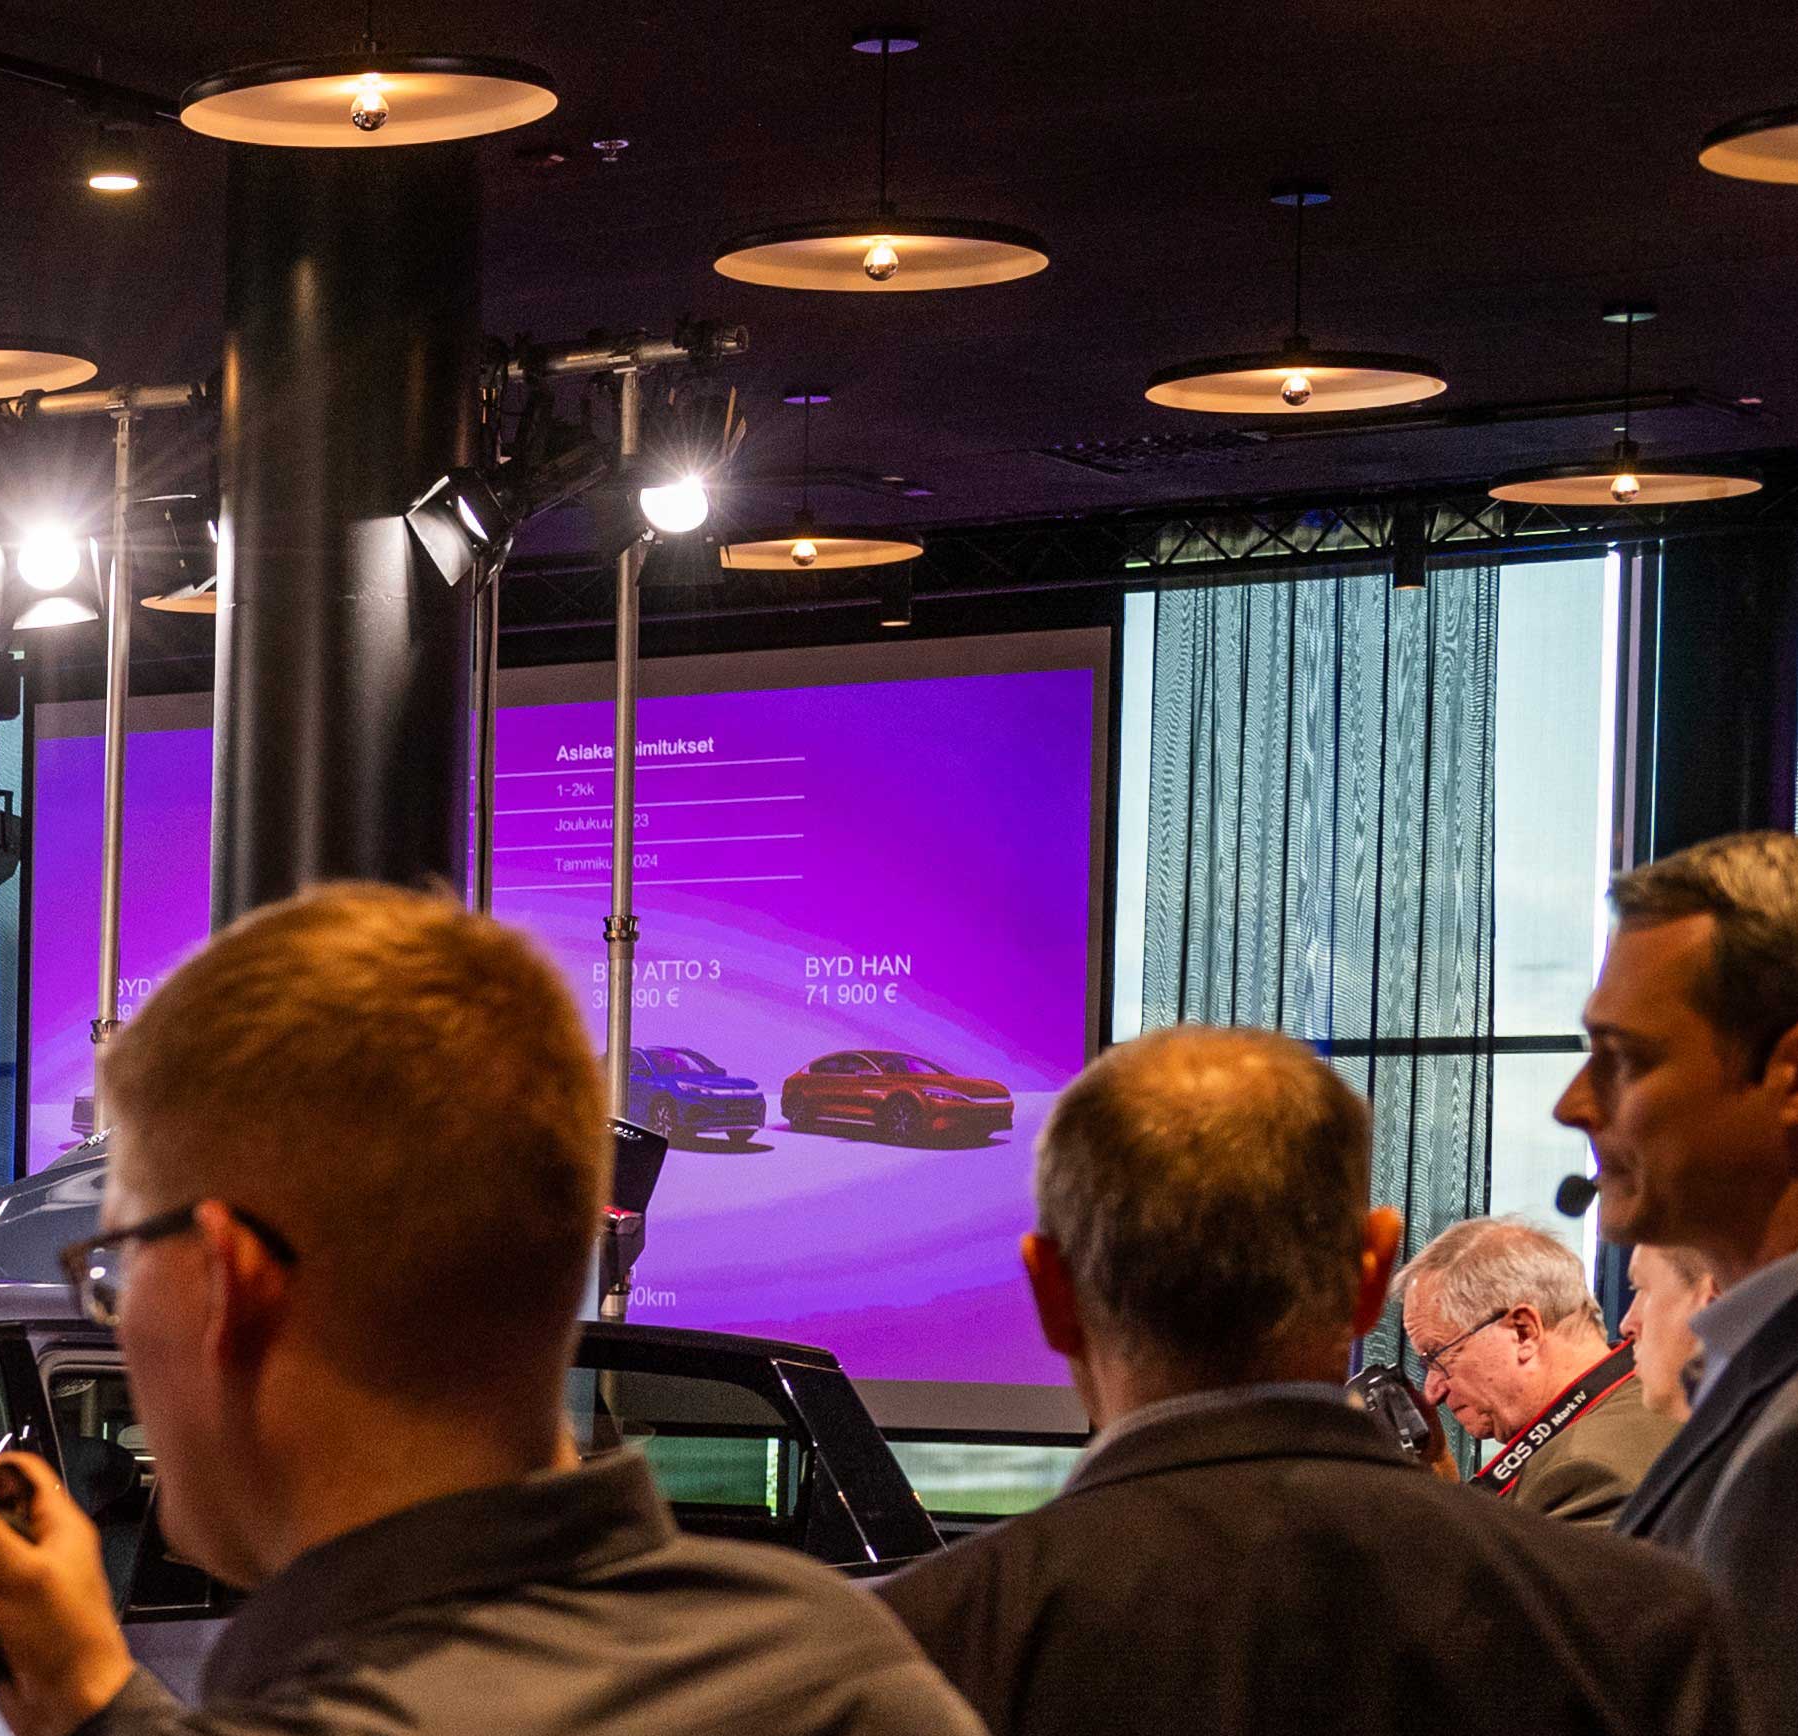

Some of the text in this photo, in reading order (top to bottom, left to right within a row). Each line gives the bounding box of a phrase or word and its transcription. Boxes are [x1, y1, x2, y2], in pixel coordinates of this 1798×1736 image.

[556, 735, 715, 762] Asiakaimitukset
[556, 782, 595, 797] 1-2kk
[555, 816, 613, 832] Joulukuu
[555, 854, 658, 872] Tammiku 024
[643, 960, 702, 981] ATTO
[708, 959, 721, 980] 3
[805, 955, 912, 978] BYD HAN
[631, 987, 661, 1009] 90
[666, 987, 681, 1008] €
[805, 983, 899, 1005] 71 900 €
[1492, 1389, 1587, 1480] EOS 5D Mark IV
